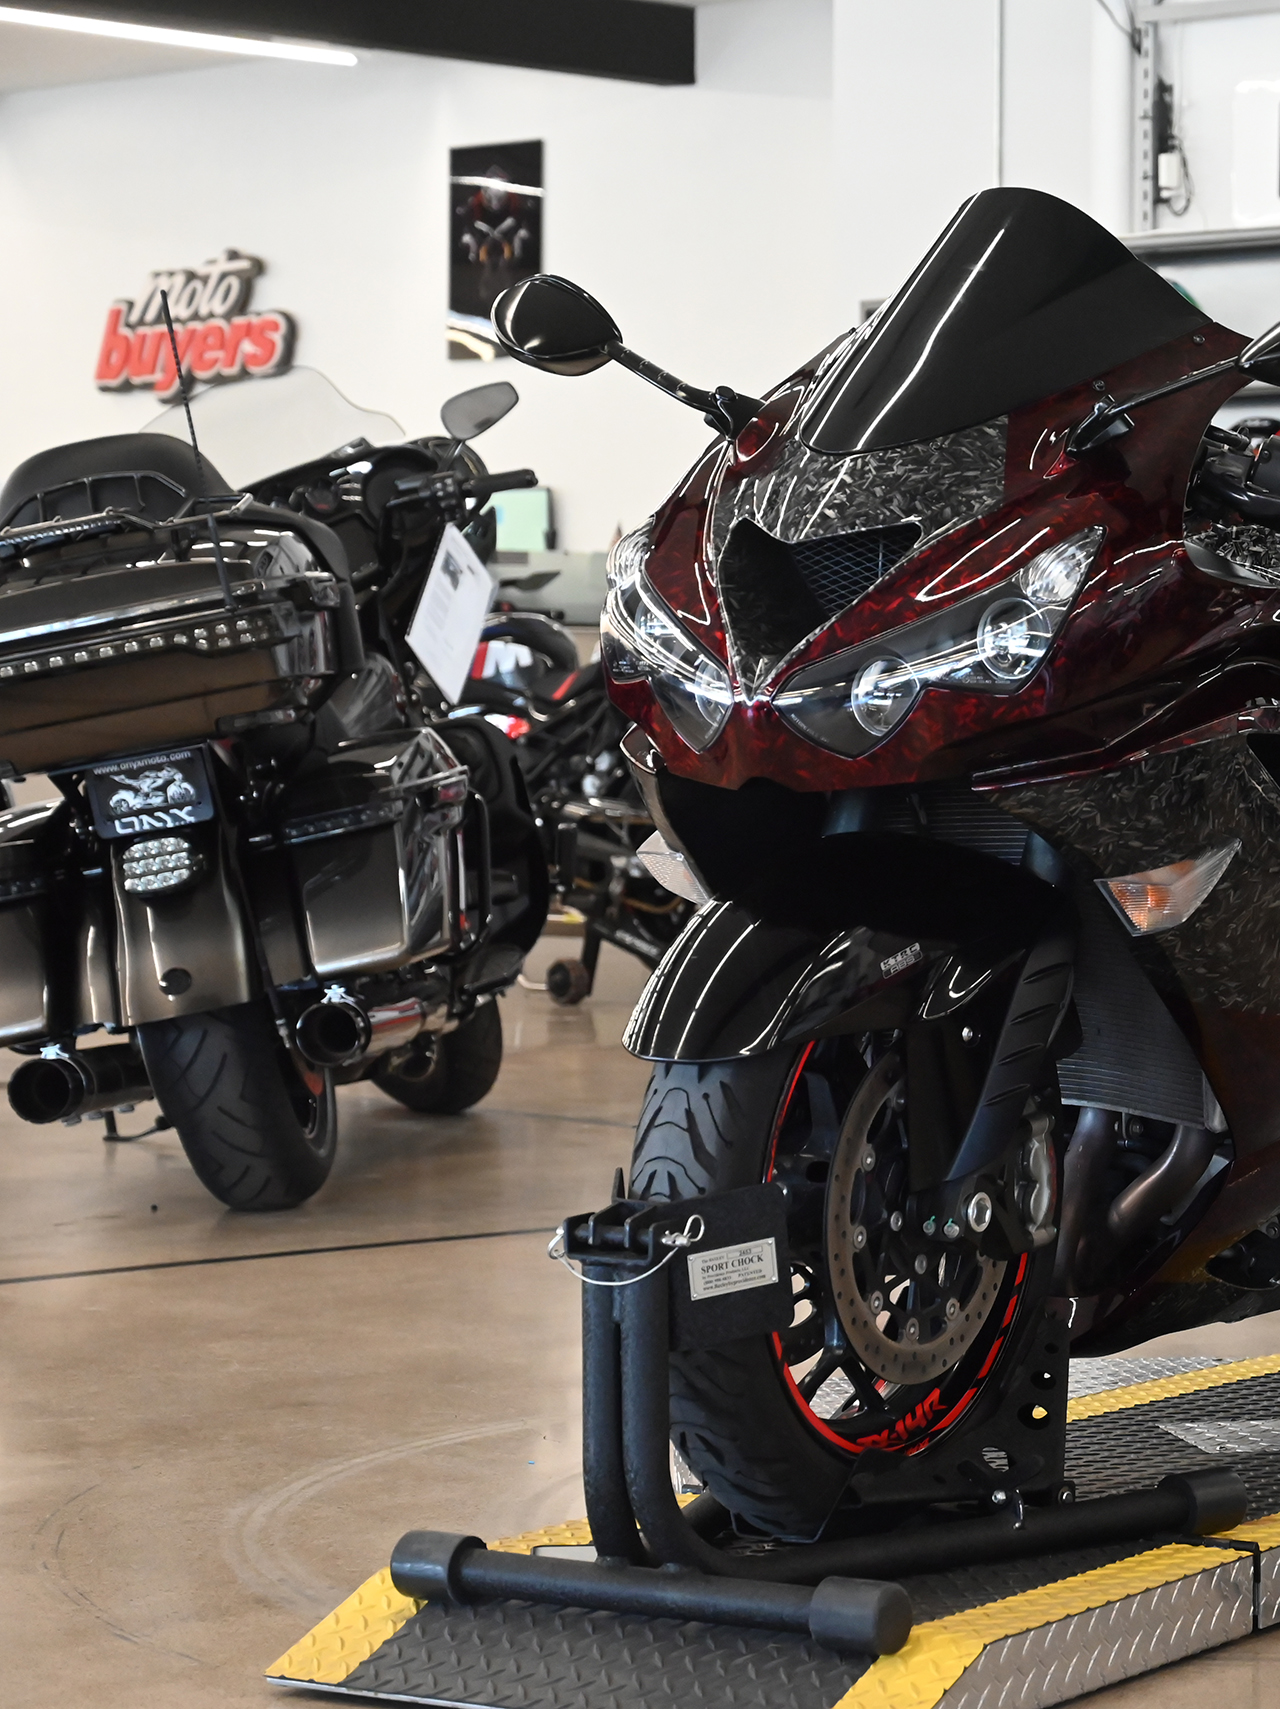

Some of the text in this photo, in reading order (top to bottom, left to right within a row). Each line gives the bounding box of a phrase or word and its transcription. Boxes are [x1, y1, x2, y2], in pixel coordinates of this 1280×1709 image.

[94, 304, 285, 396] buyers
[93, 751, 191, 775] www.onyxmoto.com
[882, 943, 919, 969] KTRC
[890, 955, 916, 974] ABS
[701, 1254, 764, 1274] SPORT CHOCK
[737, 1269, 762, 1277] PATENTED
